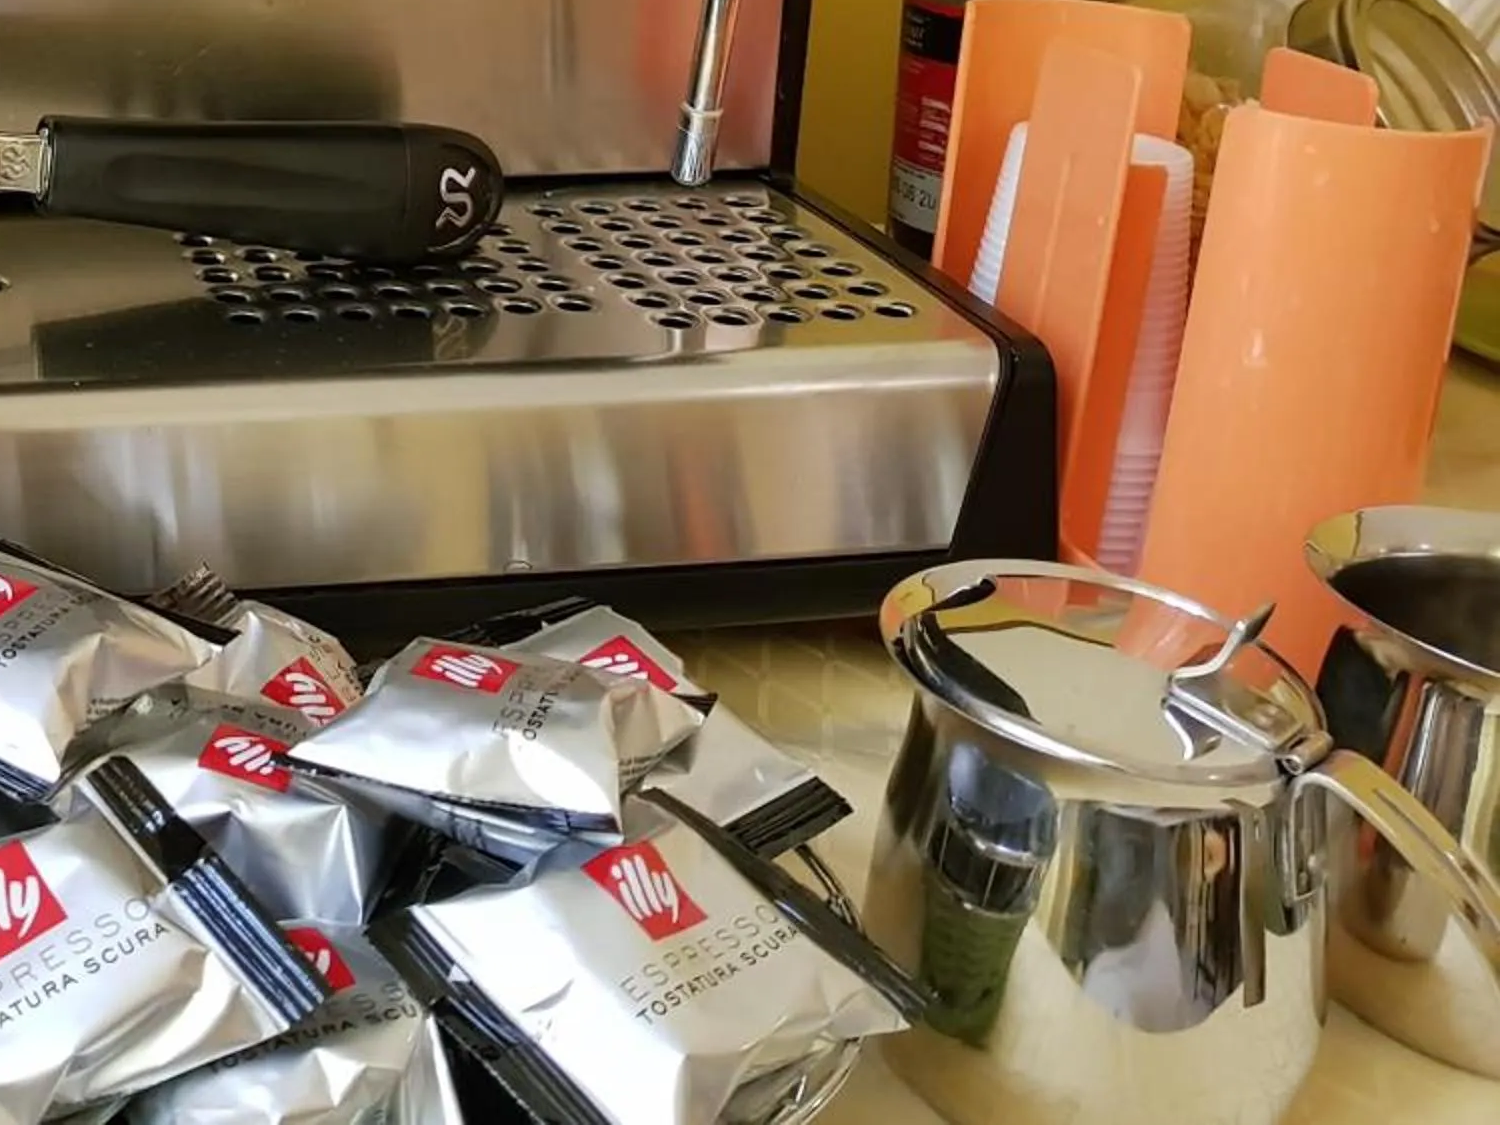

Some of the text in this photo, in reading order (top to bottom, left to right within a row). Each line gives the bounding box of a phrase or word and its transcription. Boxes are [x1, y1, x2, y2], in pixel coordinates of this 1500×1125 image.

[430, 653, 503, 688] illy
[610, 853, 680, 925] illy
[82, 922, 171, 975] SCURA
[635, 922, 801, 1026] TOSTATURA SCURA
